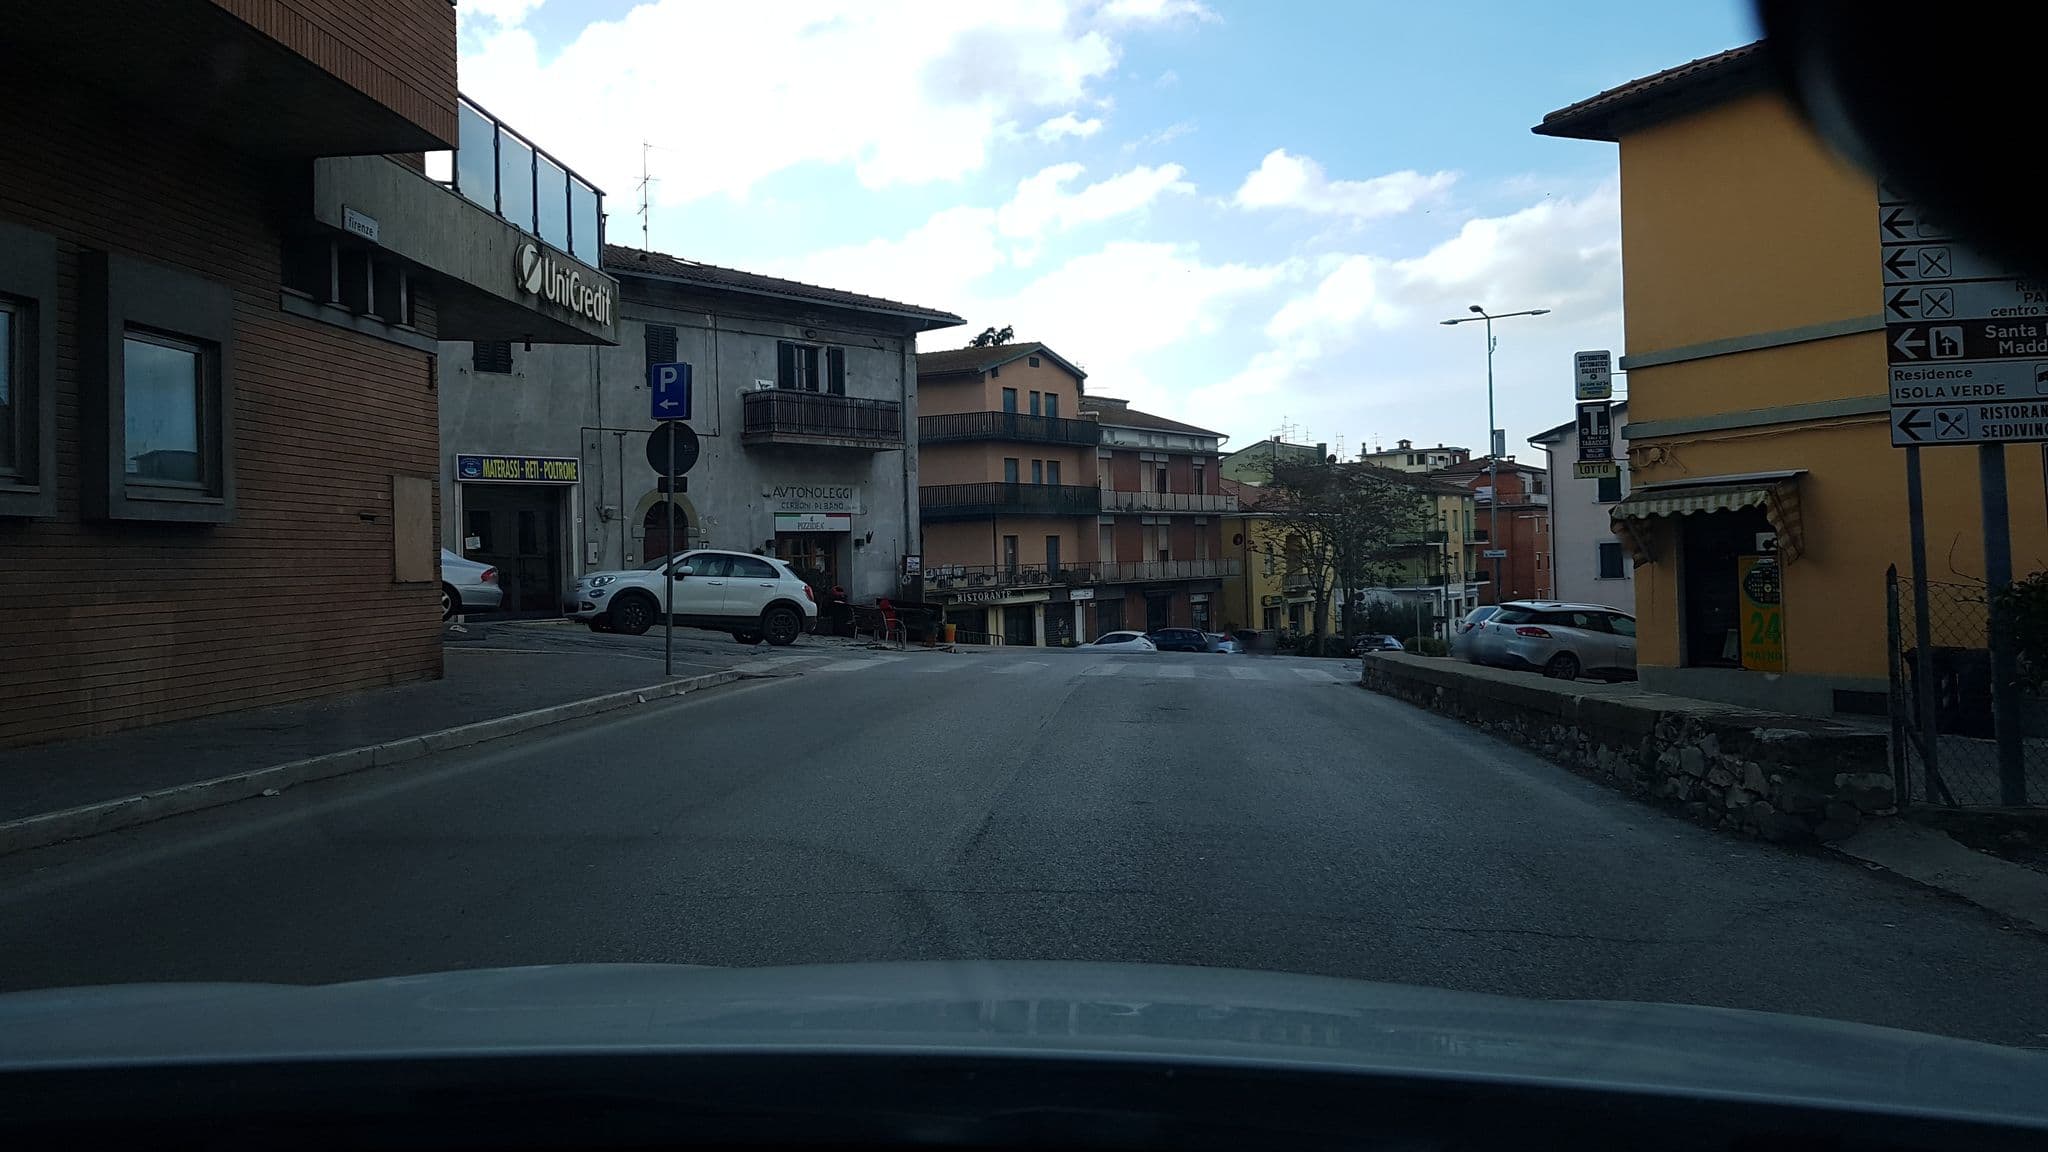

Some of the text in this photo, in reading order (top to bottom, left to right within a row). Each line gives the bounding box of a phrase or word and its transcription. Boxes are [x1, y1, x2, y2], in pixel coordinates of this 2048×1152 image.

[545, 256, 610, 326] UniCredit
[1990, 304, 2039, 317] centro
[1984, 323, 2038, 339] Santa
[660, 367, 678, 393] P
[1894, 368, 1973, 381] Residence
[1895, 384, 2006, 399] ISOLA VERDE
[1583, 406, 1605, 435] T
[483, 458, 520, 478] MATERASSI
[525, 460, 540, 479] RETI
[543, 461, 577, 480] POLTRONE
[1580, 464, 1609, 475] LOTTO
[773, 486, 853, 499] AVTONOLEGGI
[956, 590, 1012, 603] RISTORANTE
[1750, 611, 1780, 645] 24
